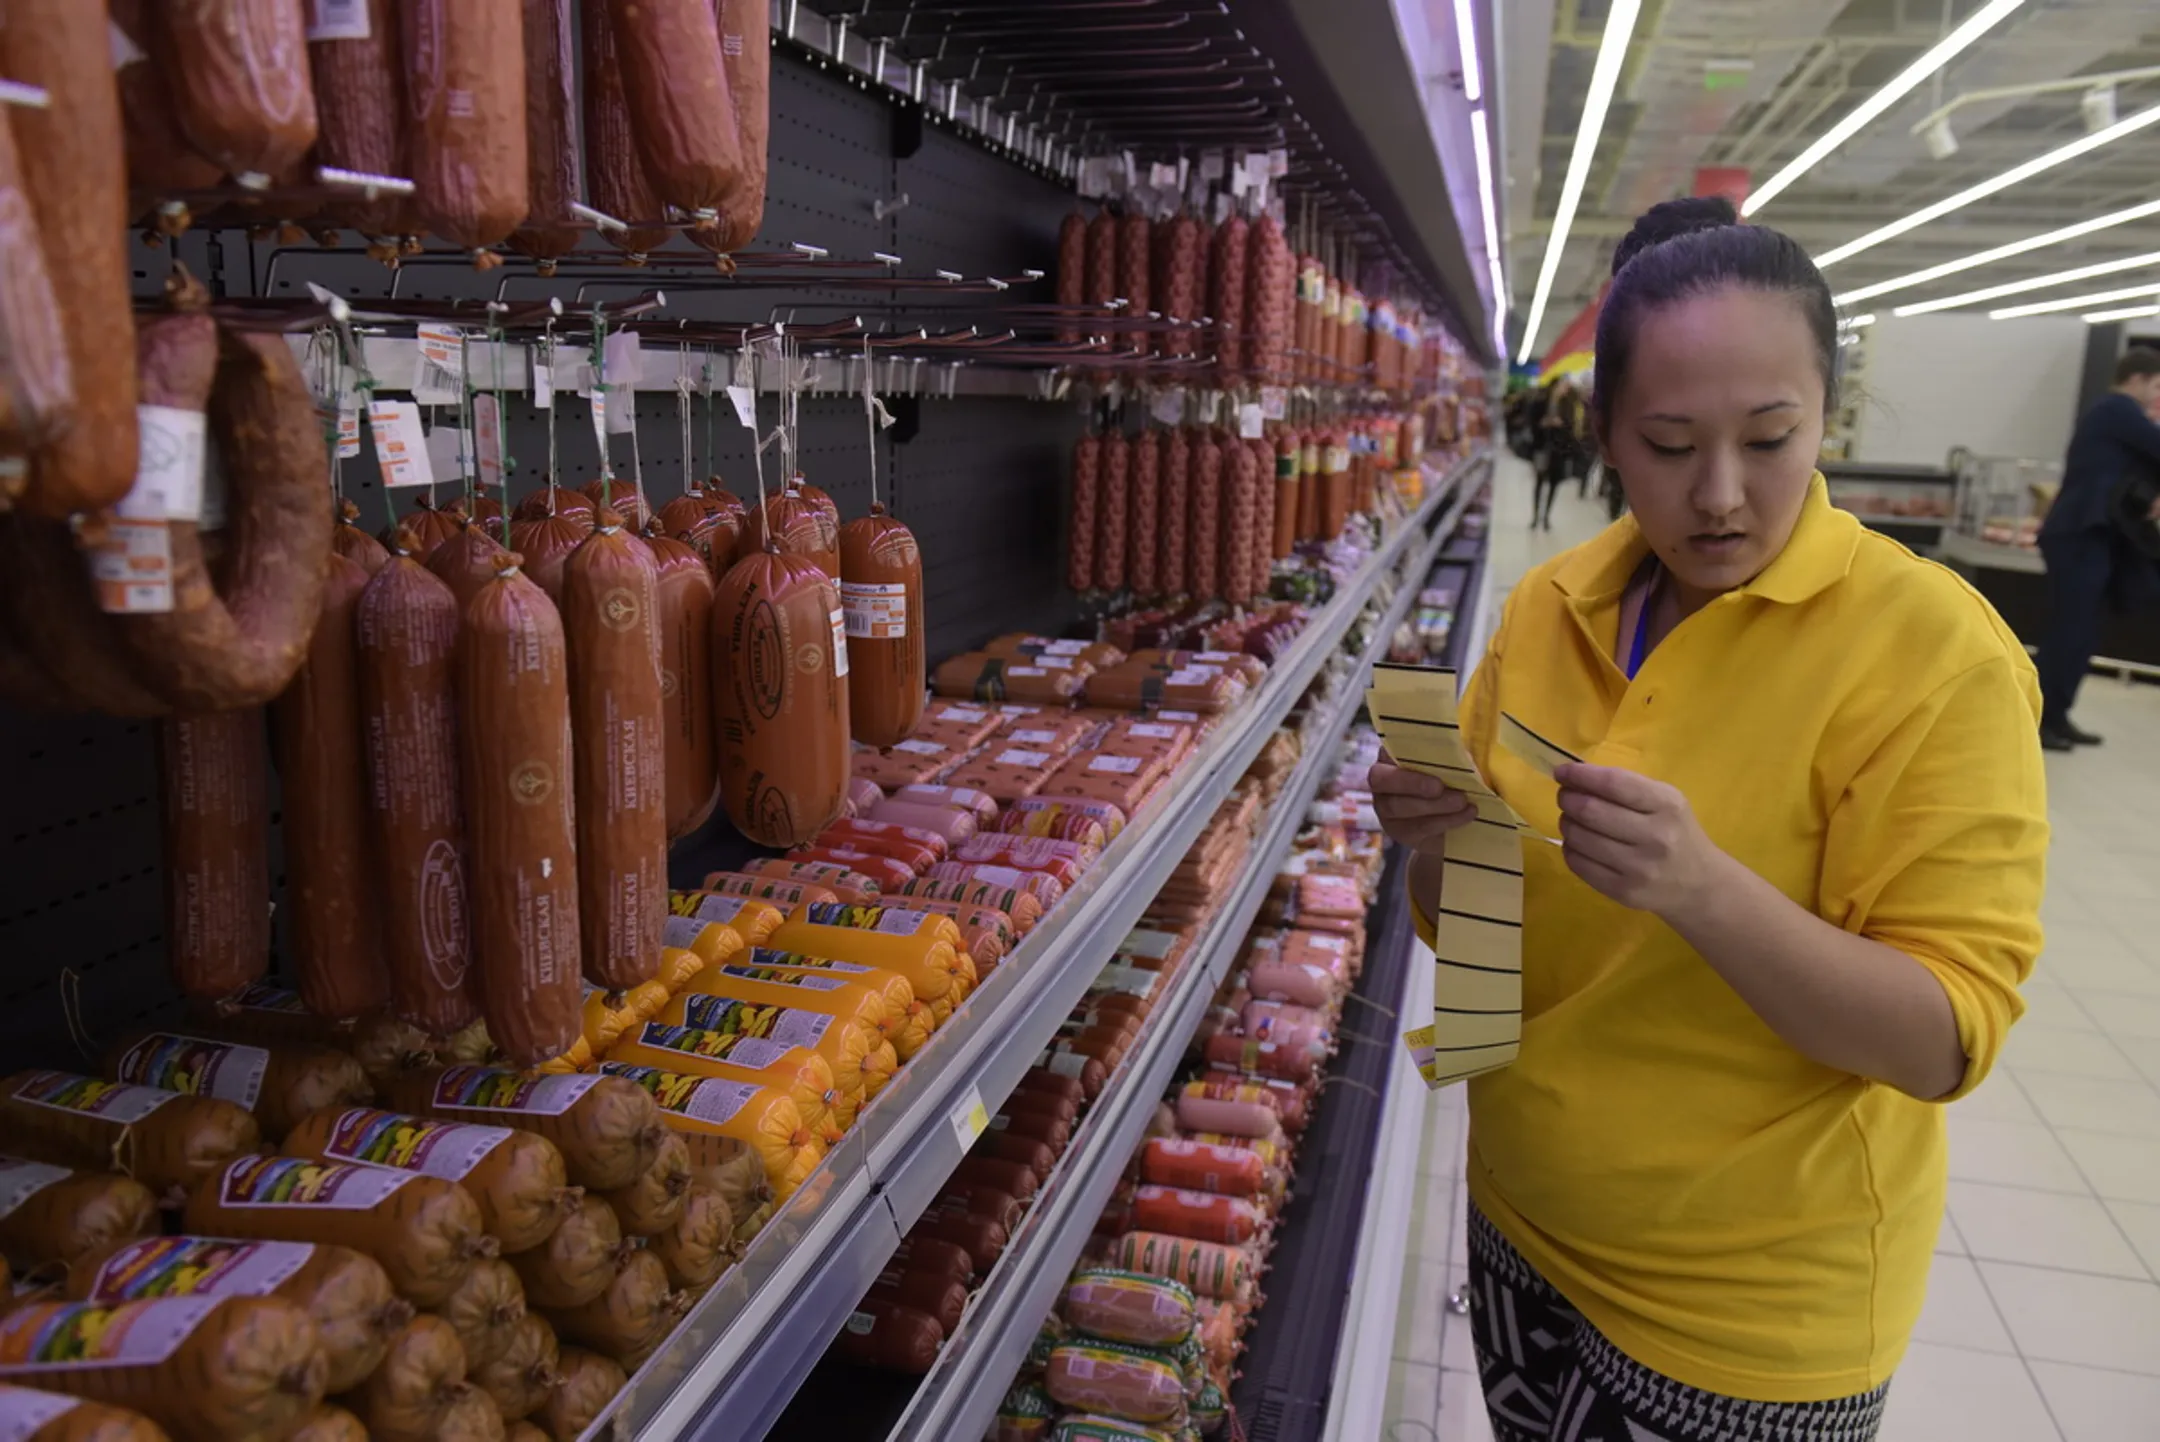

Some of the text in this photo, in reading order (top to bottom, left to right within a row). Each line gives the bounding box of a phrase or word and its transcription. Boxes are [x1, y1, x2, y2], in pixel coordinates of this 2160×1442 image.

[623, 720, 637, 809] КИЕВСКАЯ
[536, 894, 554, 984] КИЕВСКАЯ
[624, 873, 637, 956] КИЕВСКАЯ
